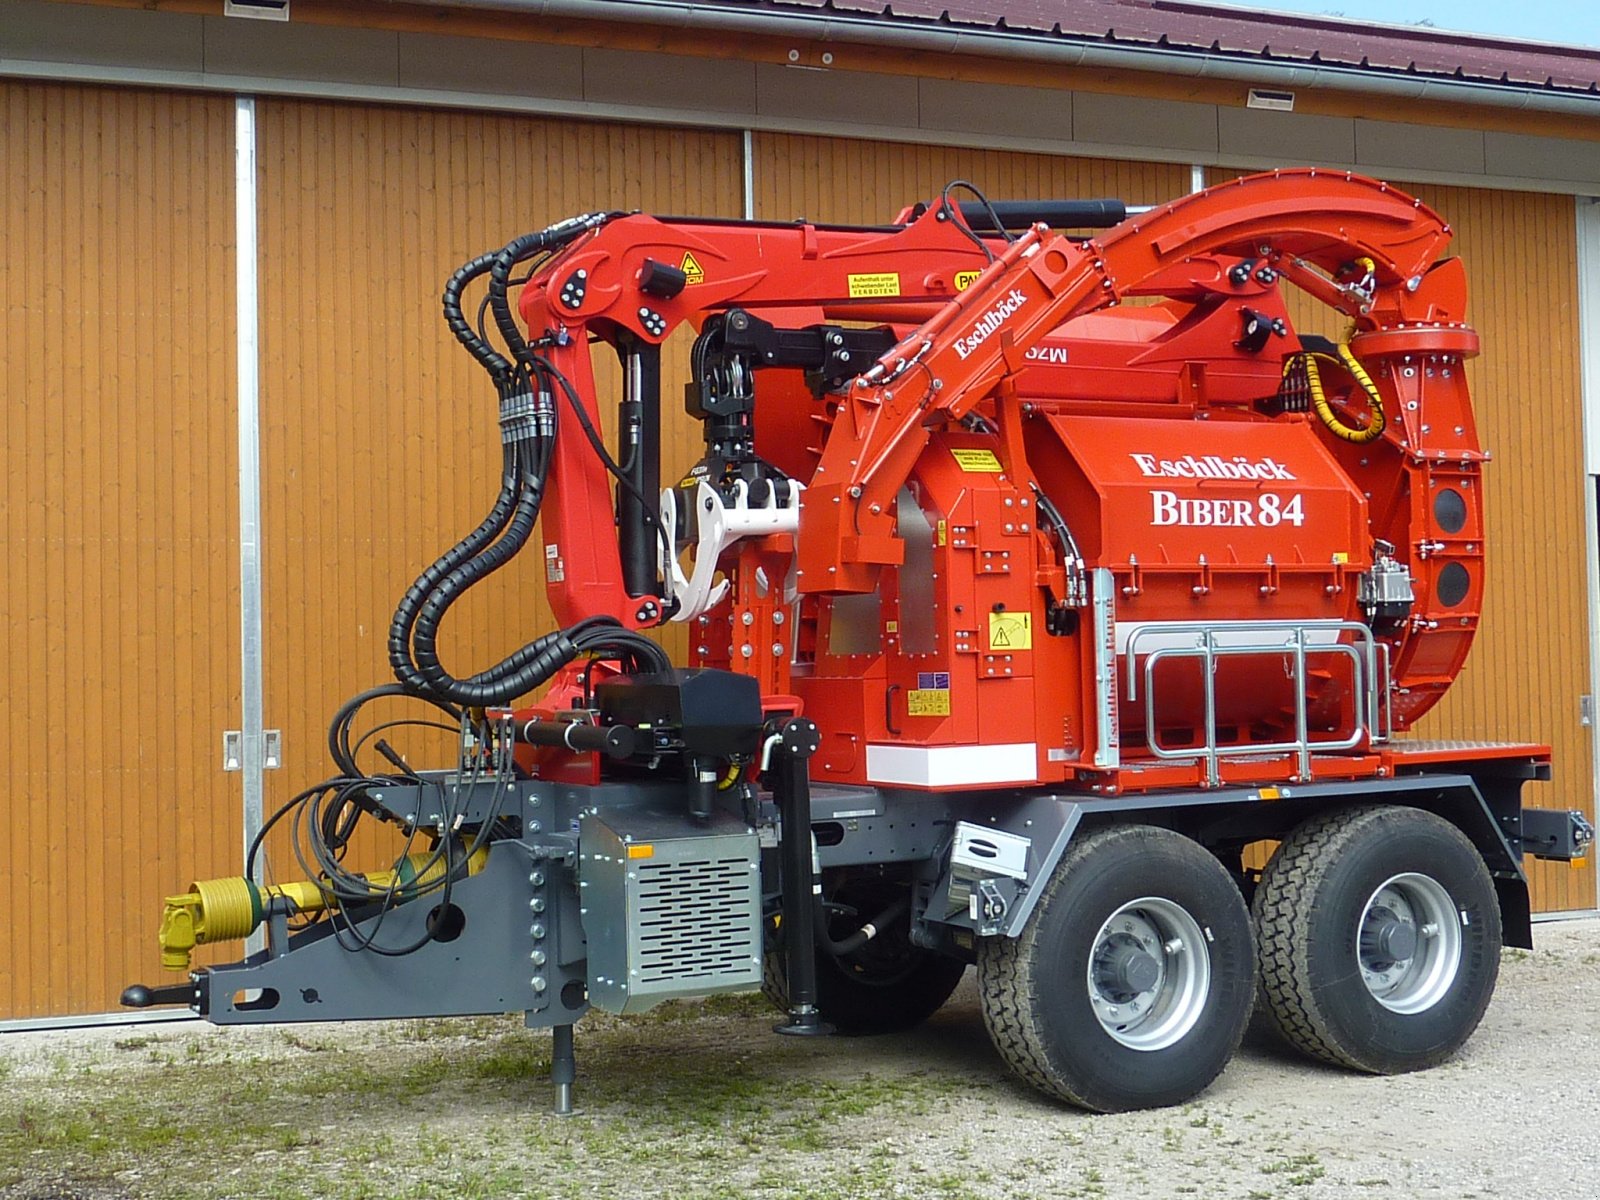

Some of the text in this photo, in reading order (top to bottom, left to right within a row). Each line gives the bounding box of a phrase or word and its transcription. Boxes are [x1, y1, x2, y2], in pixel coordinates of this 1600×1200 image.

[952, 289, 1028, 360] Eschlböck
[1129, 453, 1297, 480] Eschlböck
[1257, 493, 1305, 527] 84
